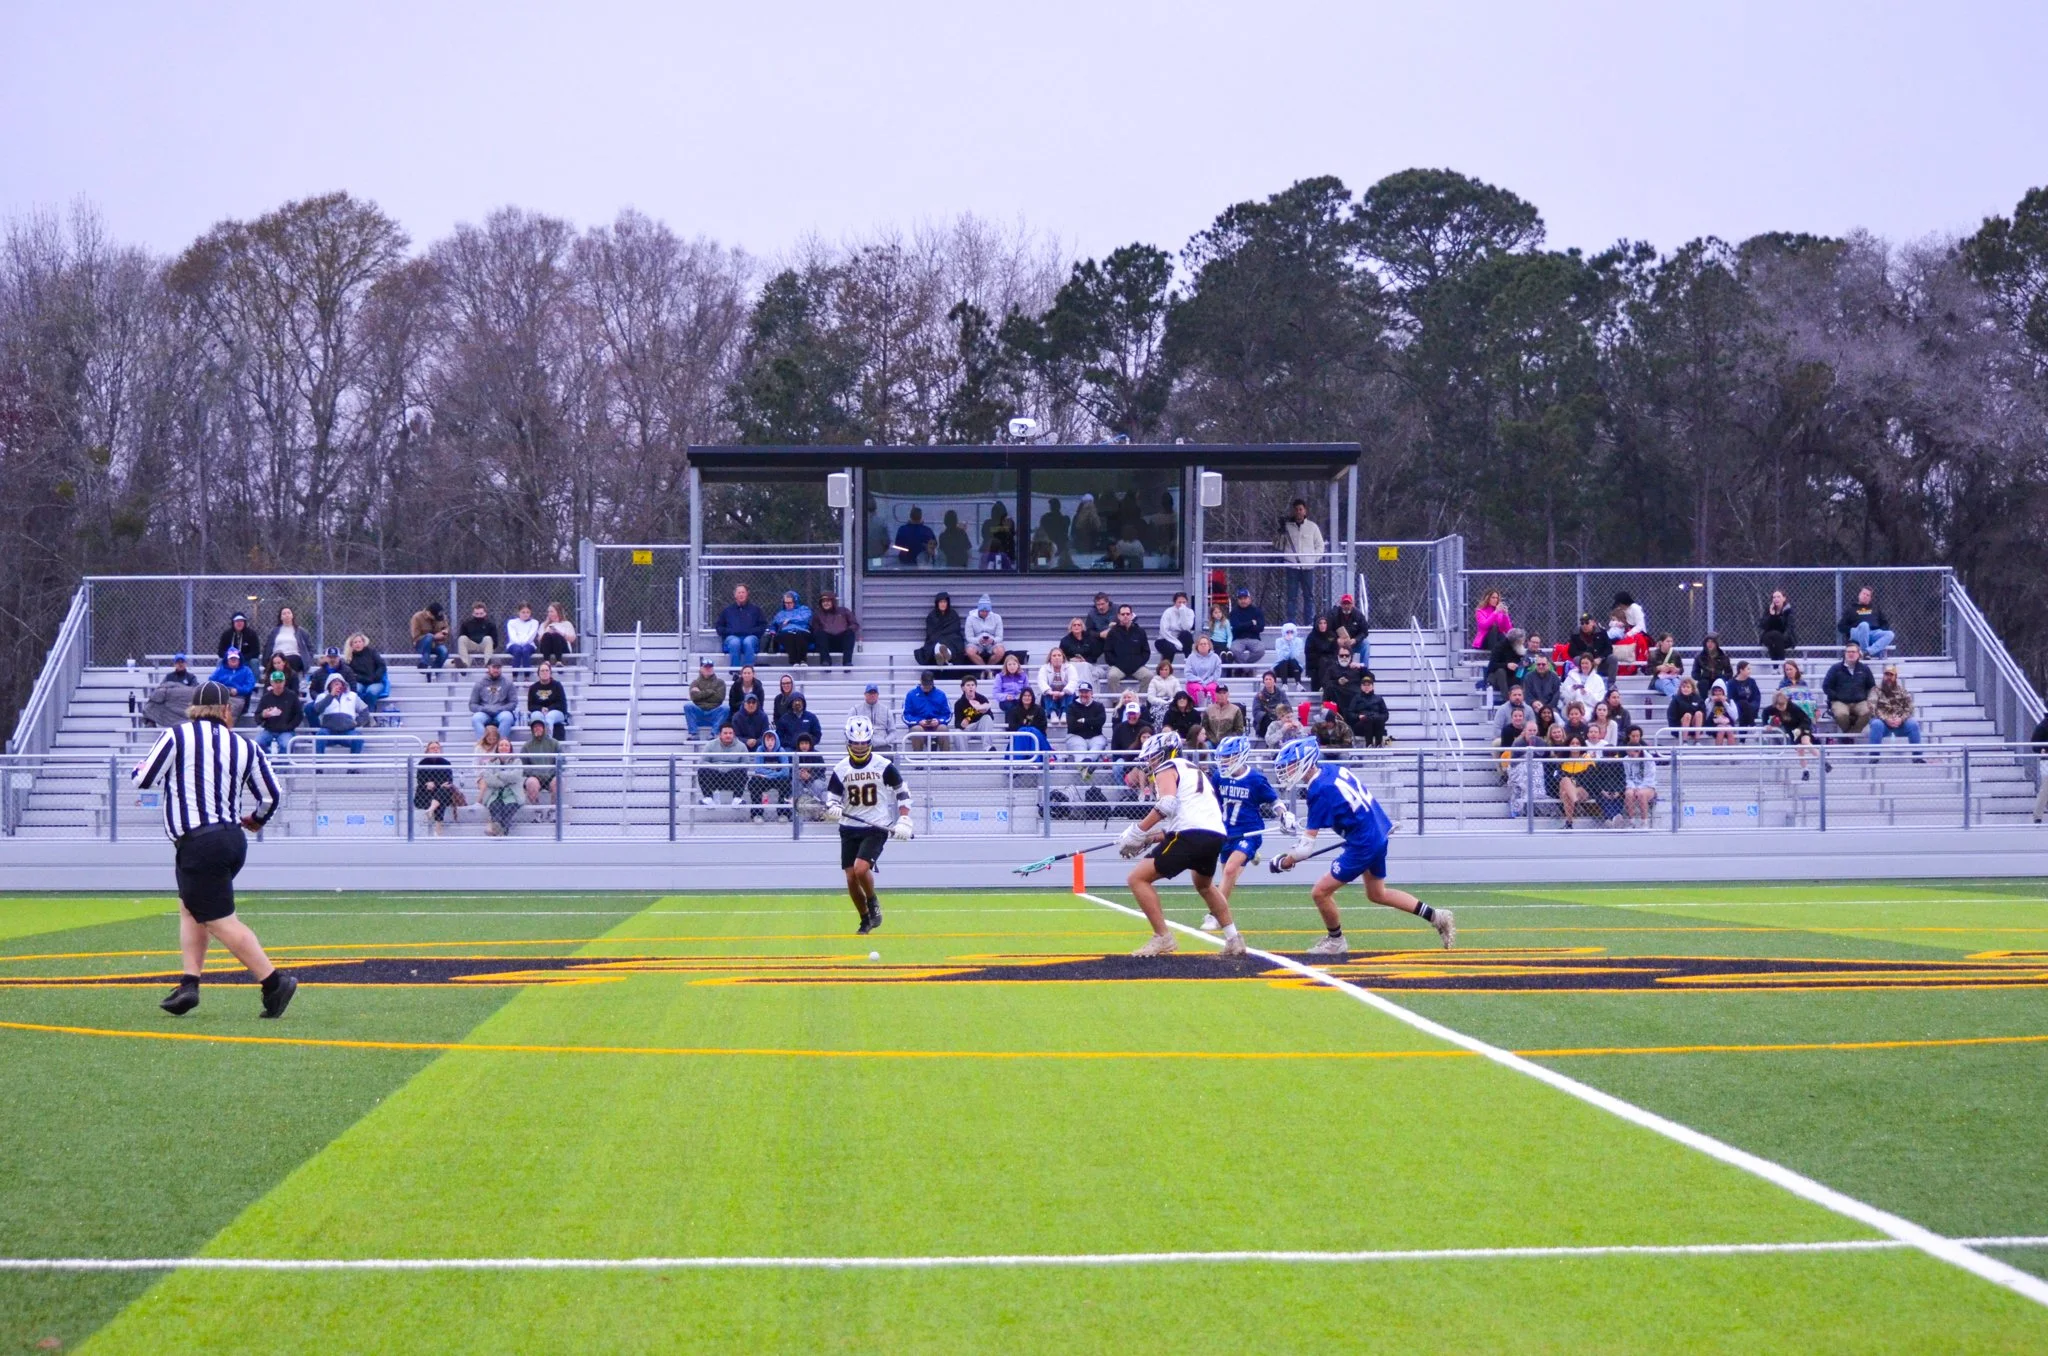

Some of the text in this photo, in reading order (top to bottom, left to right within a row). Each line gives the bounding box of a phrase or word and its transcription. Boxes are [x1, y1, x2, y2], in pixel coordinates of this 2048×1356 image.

[847, 783, 878, 806] 80
[1219, 784, 1250, 799] AY RIVER
[1334, 766, 1374, 812] 42
[1222, 797, 1243, 826] 17
